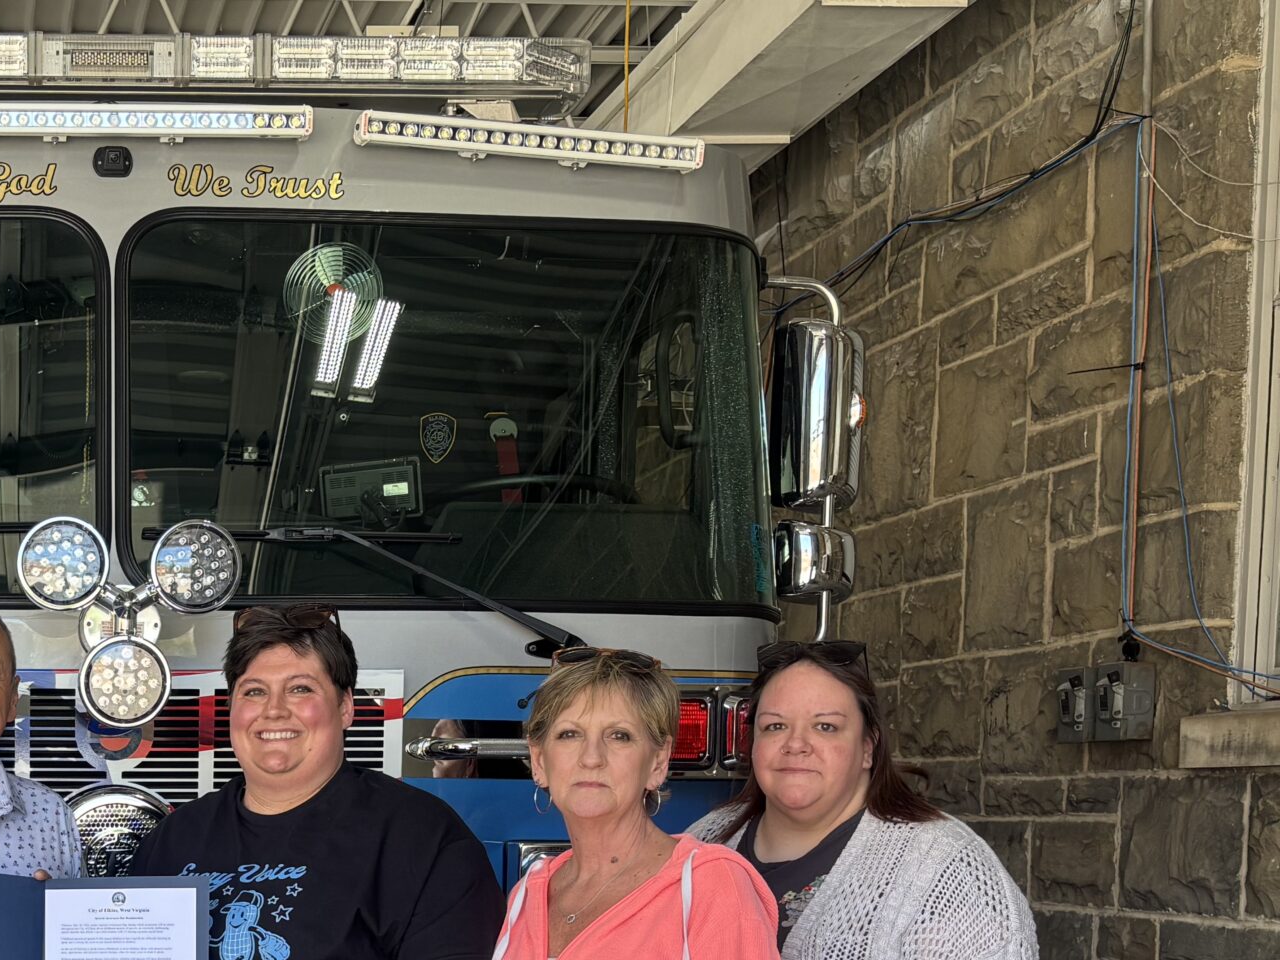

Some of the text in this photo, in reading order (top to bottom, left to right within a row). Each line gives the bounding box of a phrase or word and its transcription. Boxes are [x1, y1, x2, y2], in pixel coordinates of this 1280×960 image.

[168, 163, 345, 200] We Trust
[238, 863, 308, 883] Voice
